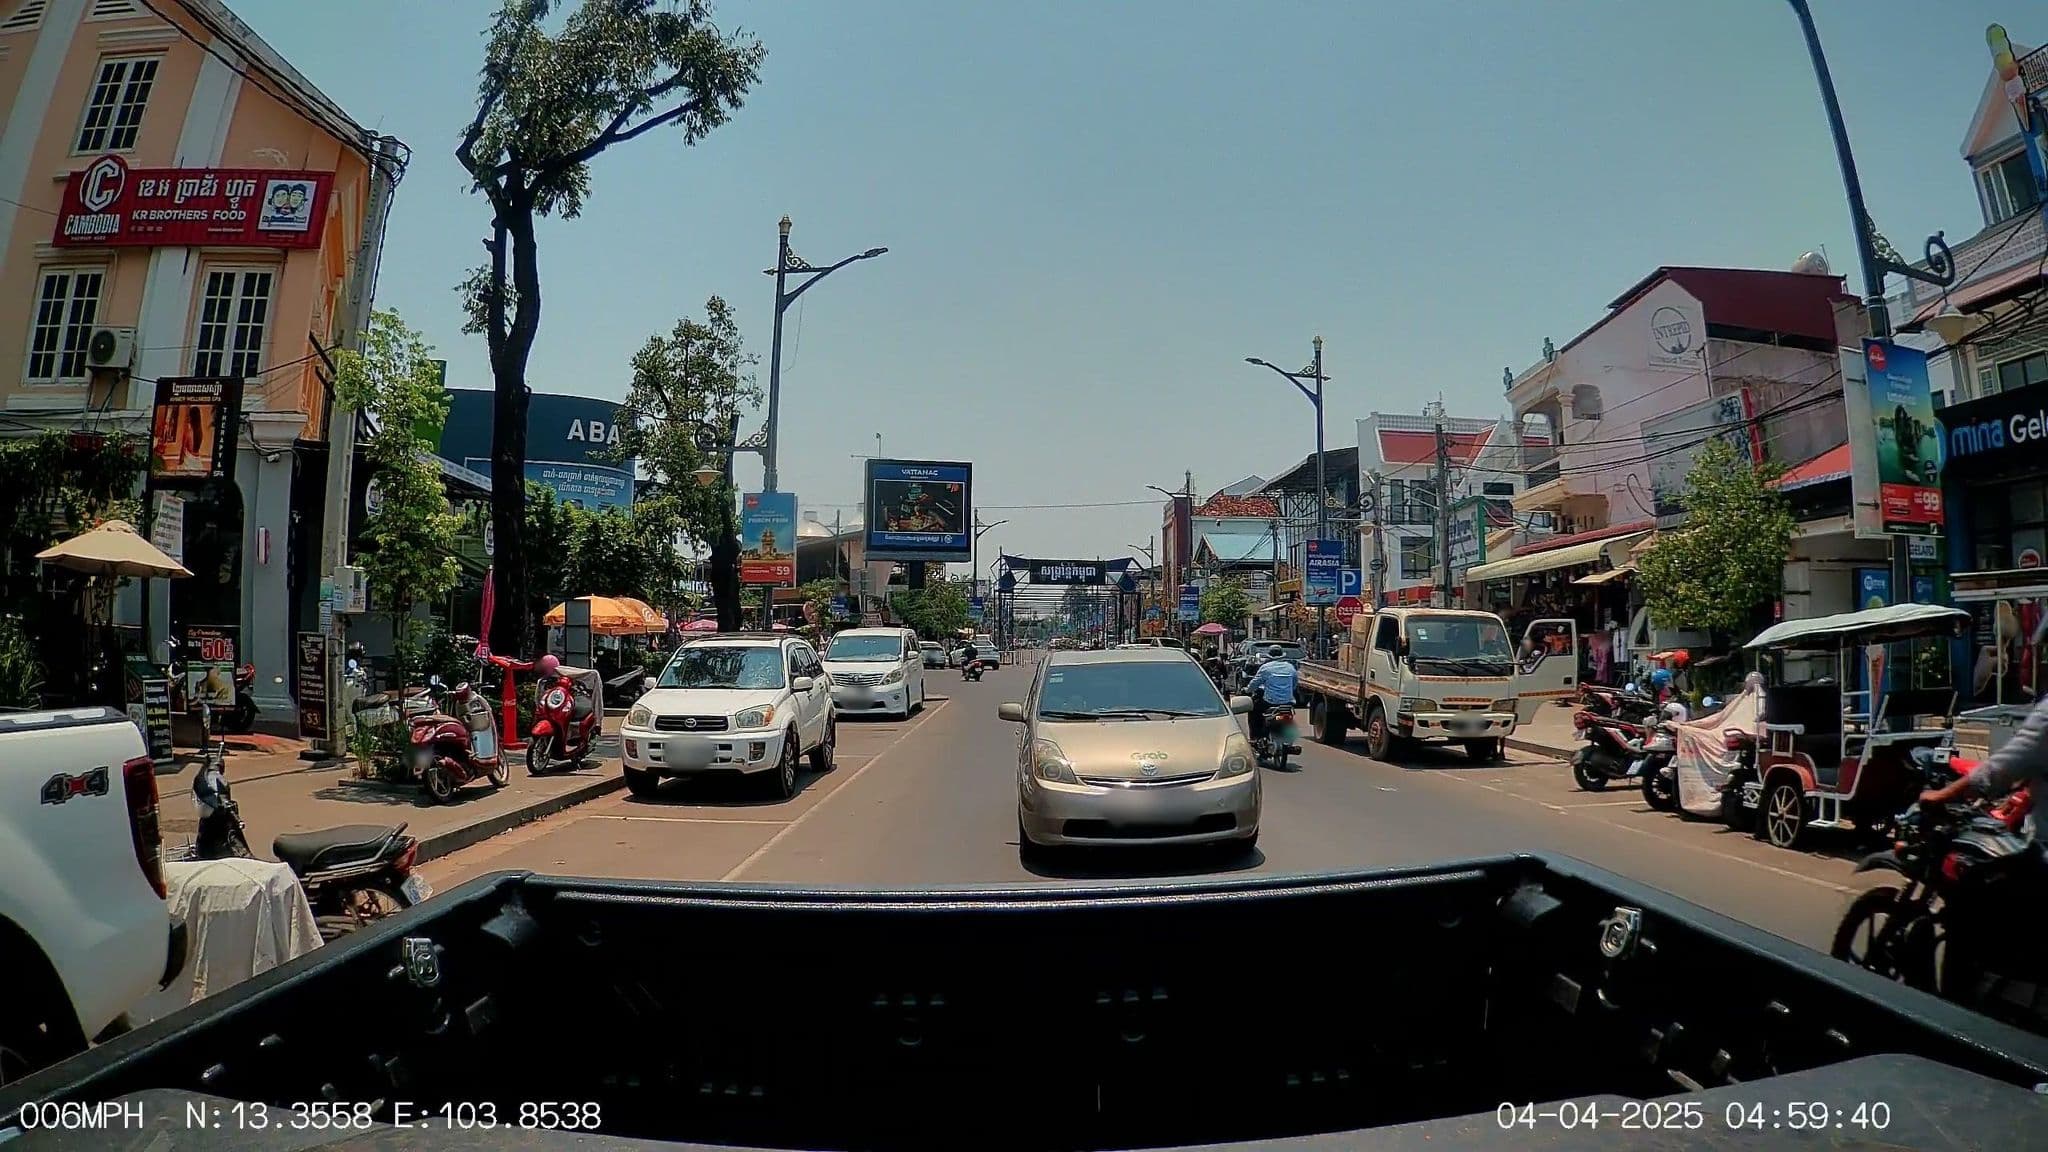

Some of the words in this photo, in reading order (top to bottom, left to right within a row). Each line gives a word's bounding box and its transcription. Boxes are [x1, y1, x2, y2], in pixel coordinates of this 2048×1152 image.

[132, 209, 149, 220] KR
[149, 209, 208, 220] BROTHERS
[212, 208, 247, 220] FOOD
[64, 214, 120, 235] CAMBODIA
[567, 418, 620, 445] ABA
[1951, 418, 2005, 457] mina
[2009, 408, 2048, 444] Gel
[1923, 491, 1941, 511] 99
[776, 566, 790, 575] 59
[1308, 559, 1340, 567] AIRASIA
[1341, 571, 1357, 594] P
[201, 637, 225, 661] 50
[1130, 751, 1168, 760] Grab
